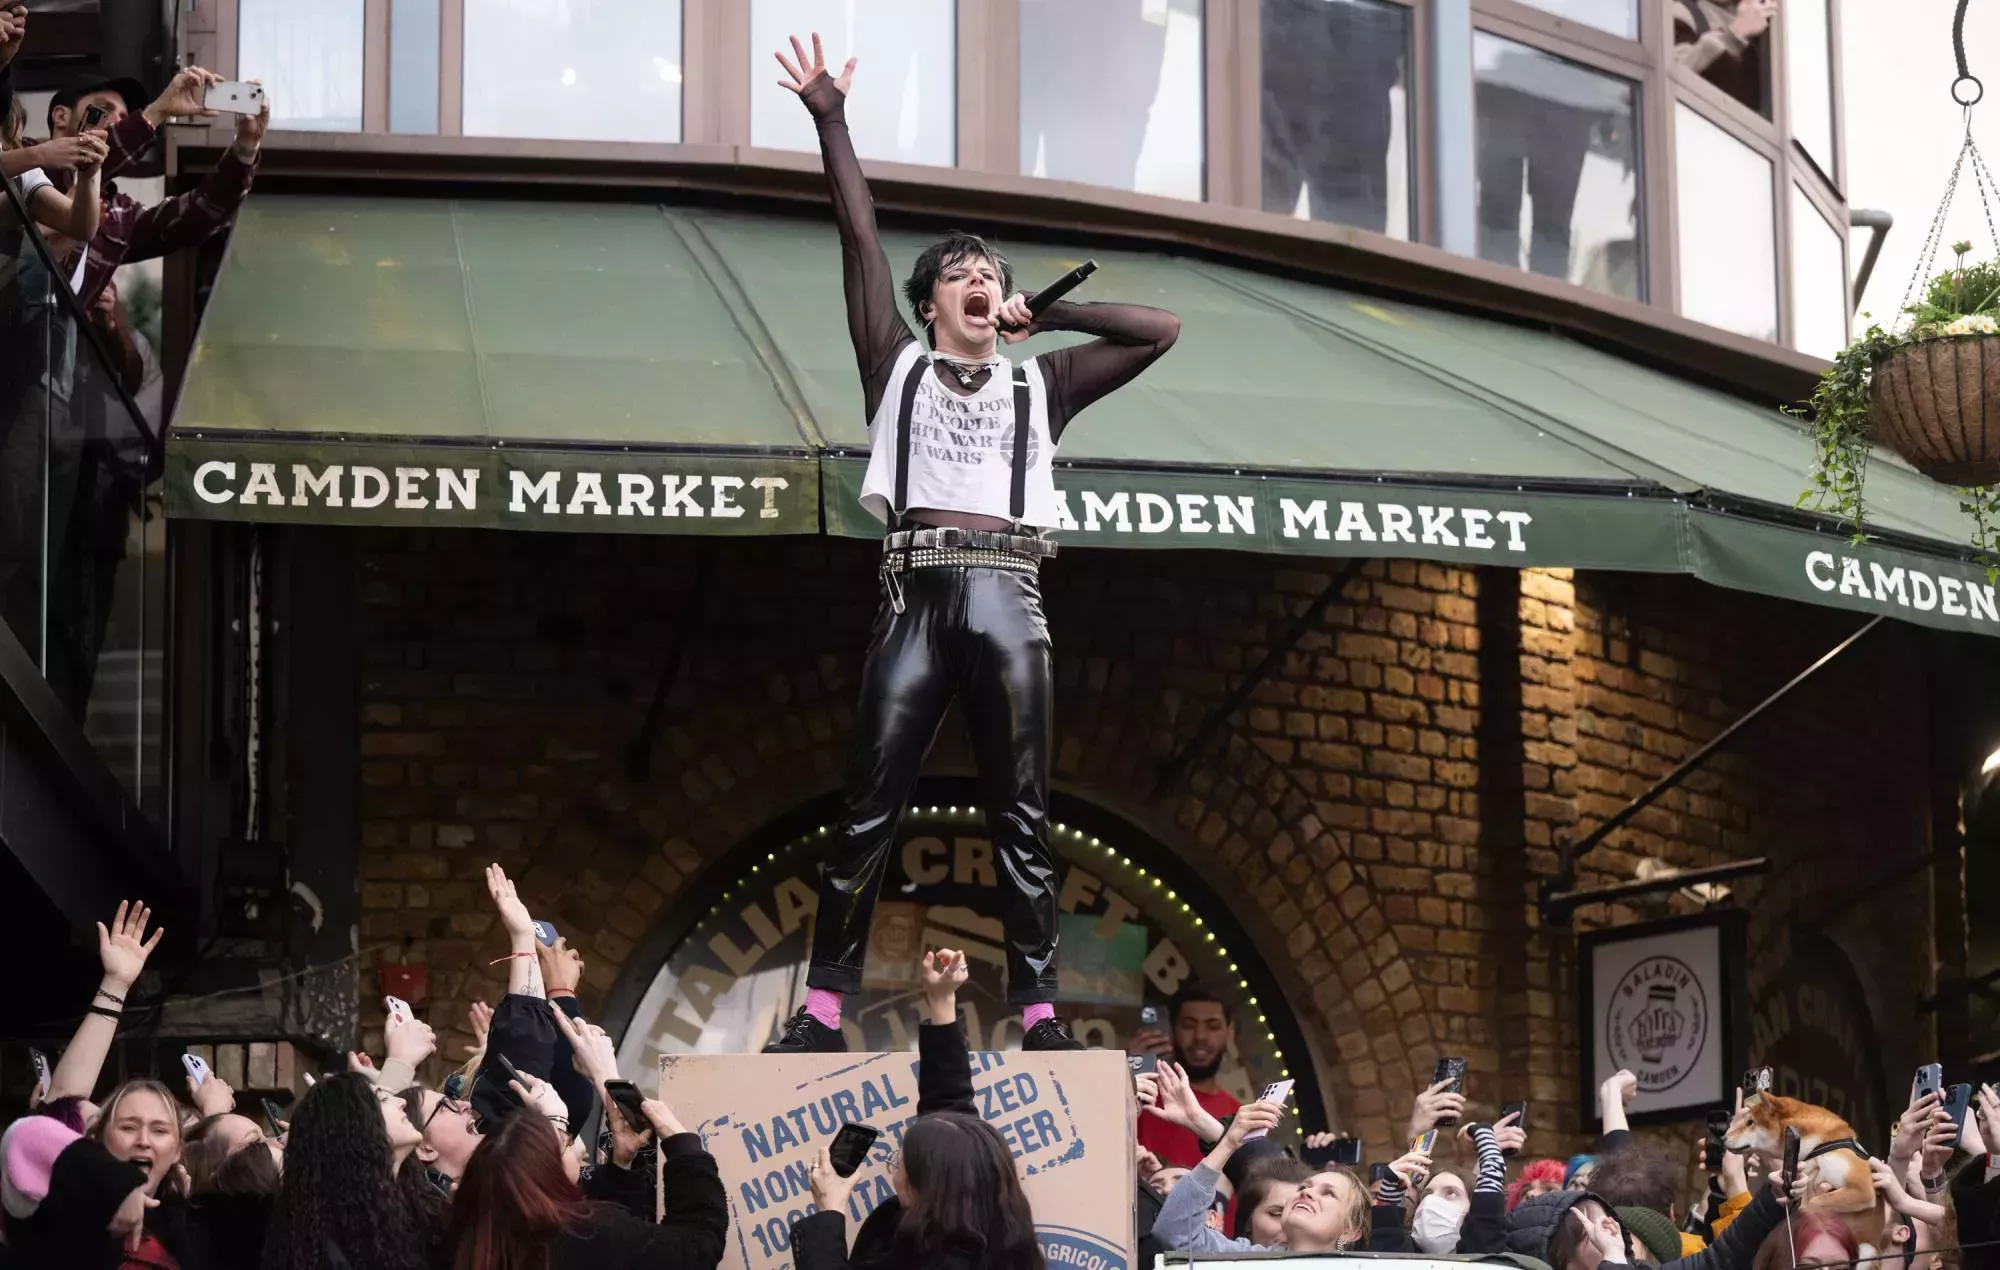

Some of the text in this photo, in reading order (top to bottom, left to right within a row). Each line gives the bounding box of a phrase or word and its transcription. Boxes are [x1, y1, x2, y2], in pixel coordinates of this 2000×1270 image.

[926, 445, 982, 465] WARS
[948, 431, 993, 448] WAR
[192, 460, 790, 519] CAMDEN MARKET
[1051, 489, 1533, 552] AMDEN MARKET
[1805, 550, 2000, 622] CAMDEN
[902, 834, 1140, 941] CRFT
[740, 1073, 909, 1164] NATURAL
